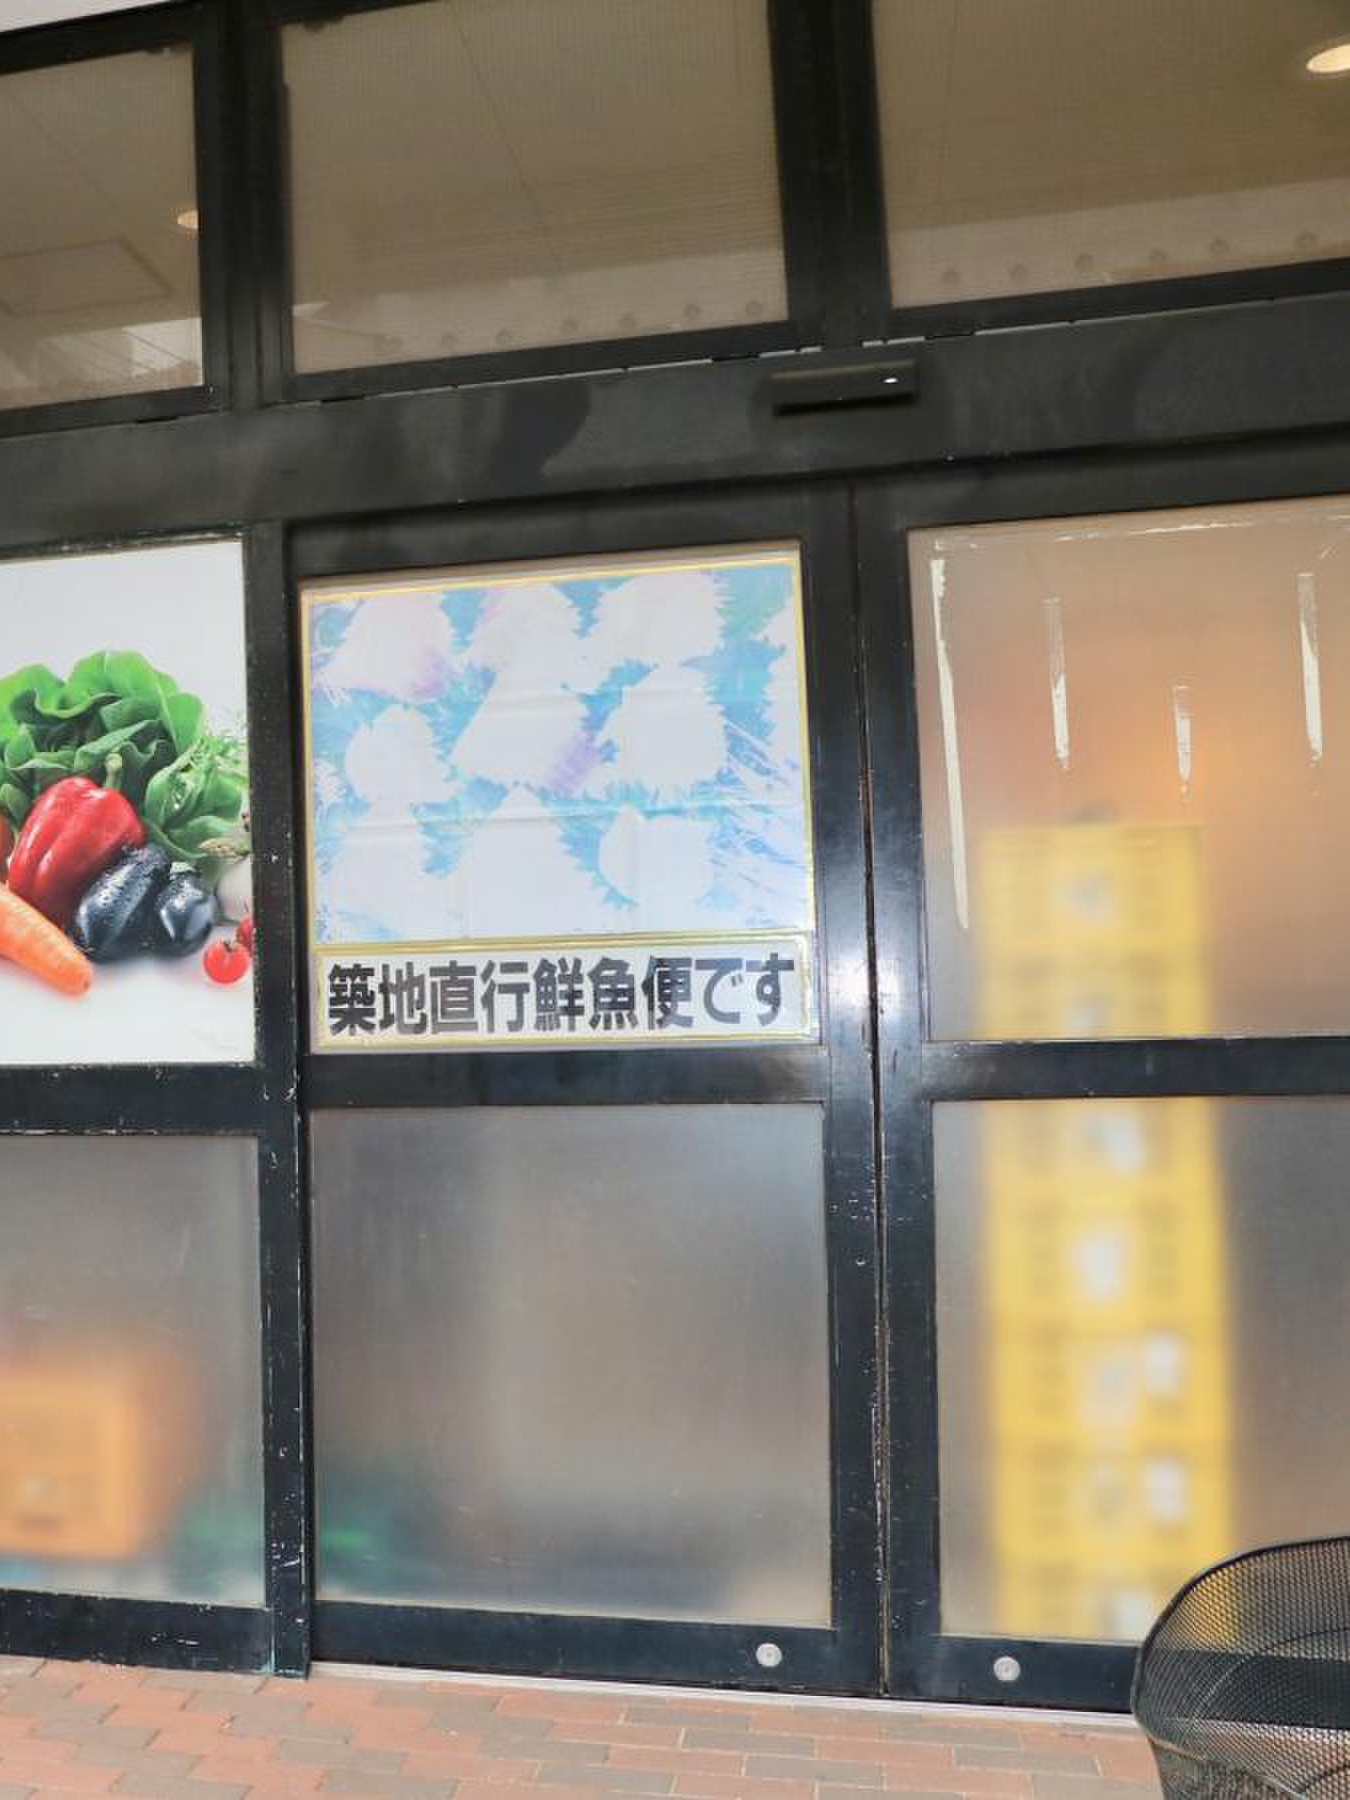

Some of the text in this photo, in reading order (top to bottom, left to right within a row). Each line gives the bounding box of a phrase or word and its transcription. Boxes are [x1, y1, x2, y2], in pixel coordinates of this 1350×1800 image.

[328, 953, 795, 1037] 築地直行鮮魚便です
